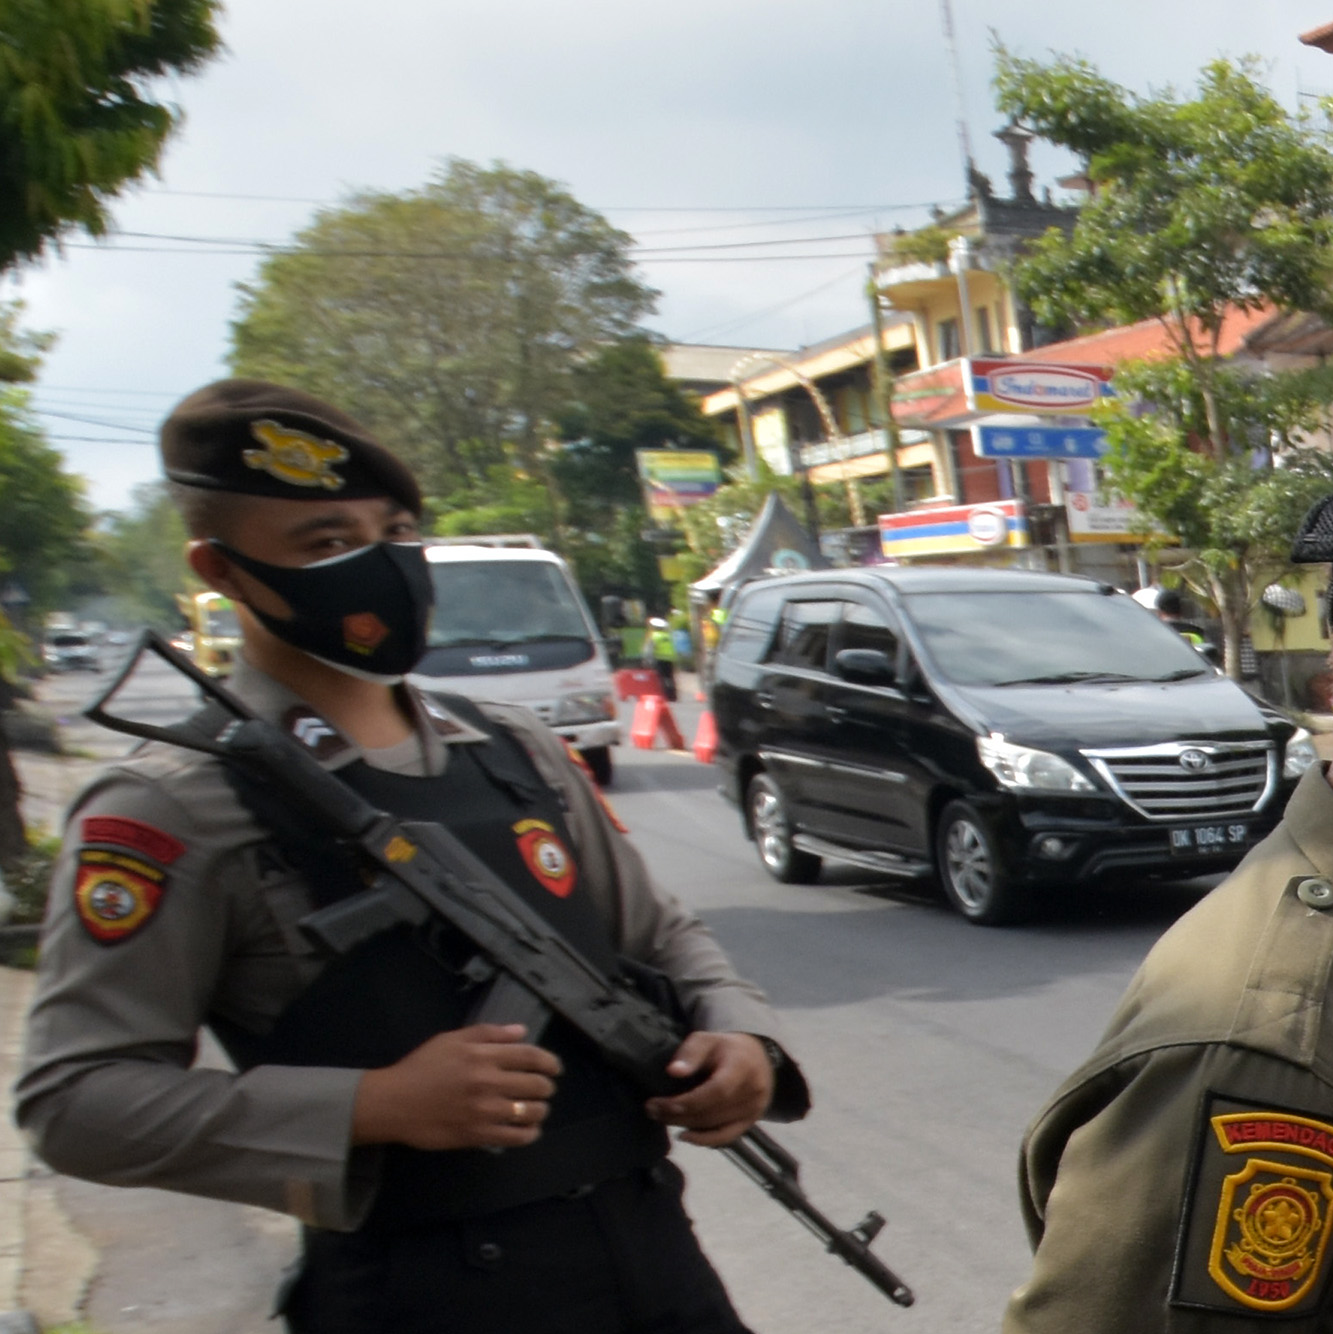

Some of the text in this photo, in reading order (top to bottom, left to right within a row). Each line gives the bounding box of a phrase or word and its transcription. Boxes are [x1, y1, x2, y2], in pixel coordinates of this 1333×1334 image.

[1172, 824, 1246, 848] DK 1064 SP
